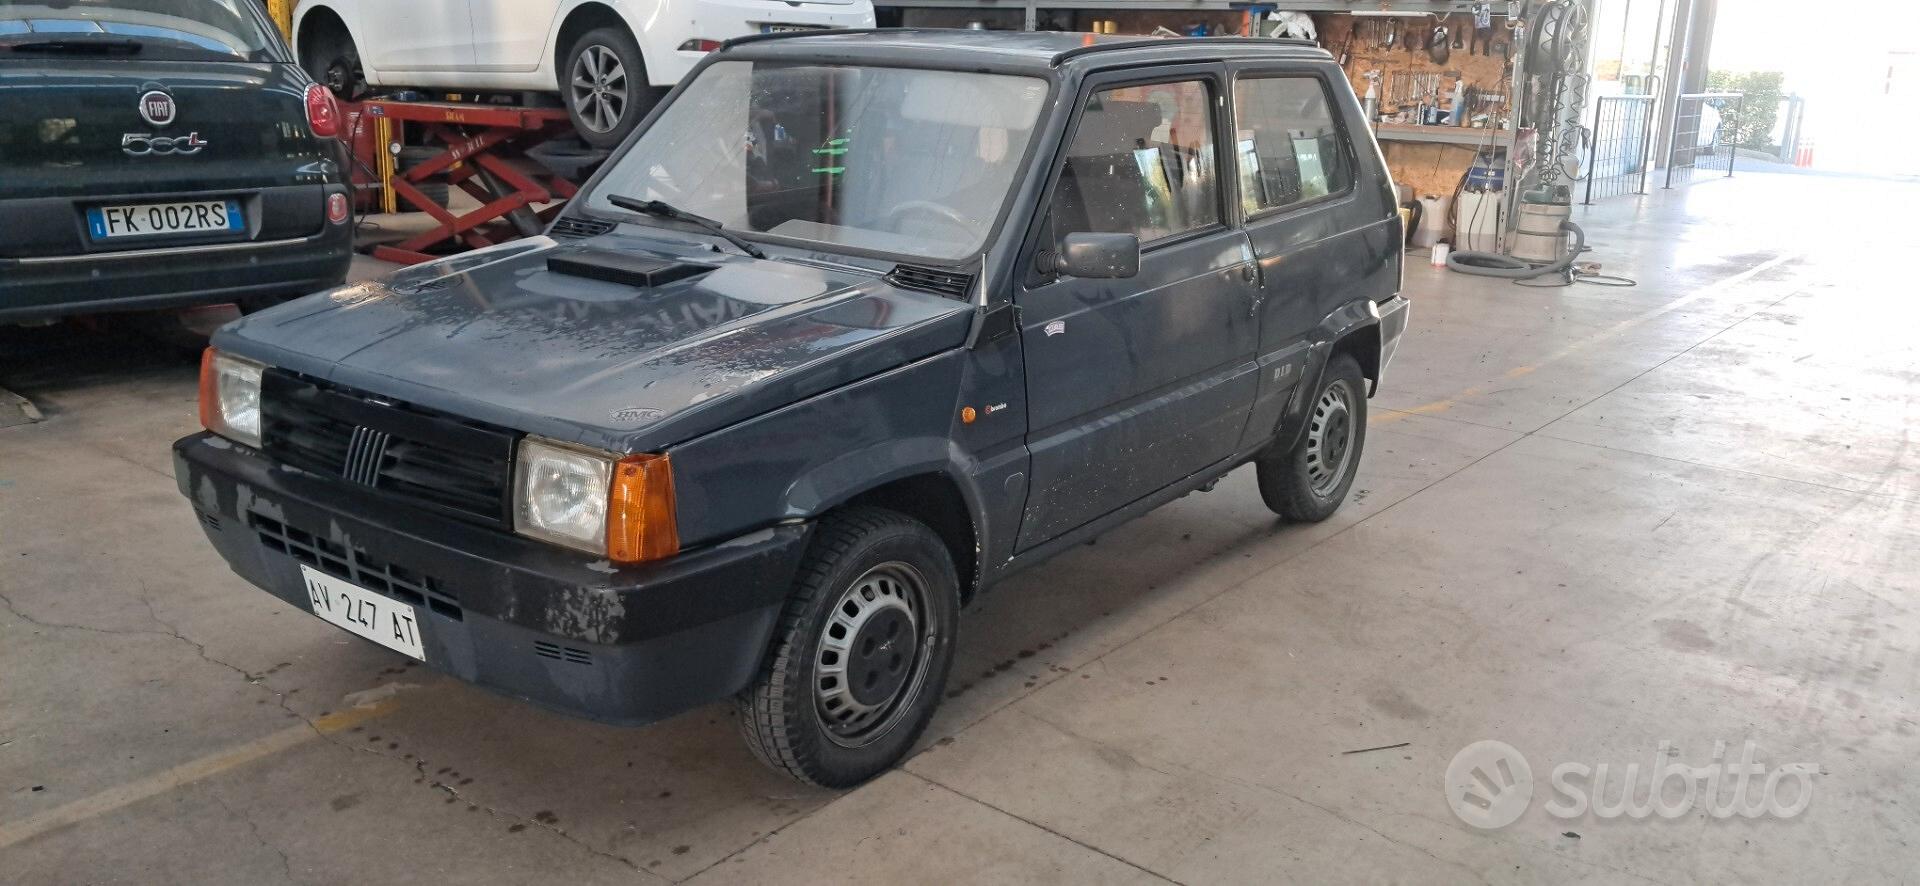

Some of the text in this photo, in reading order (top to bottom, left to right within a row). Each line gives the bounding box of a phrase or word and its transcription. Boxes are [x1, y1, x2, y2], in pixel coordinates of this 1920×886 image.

[149, 101, 169, 117] FIAT
[121, 132, 208, 156] 500L
[106, 204, 226, 234] FK 002RS
[309, 579, 415, 647] AV 247 AT
